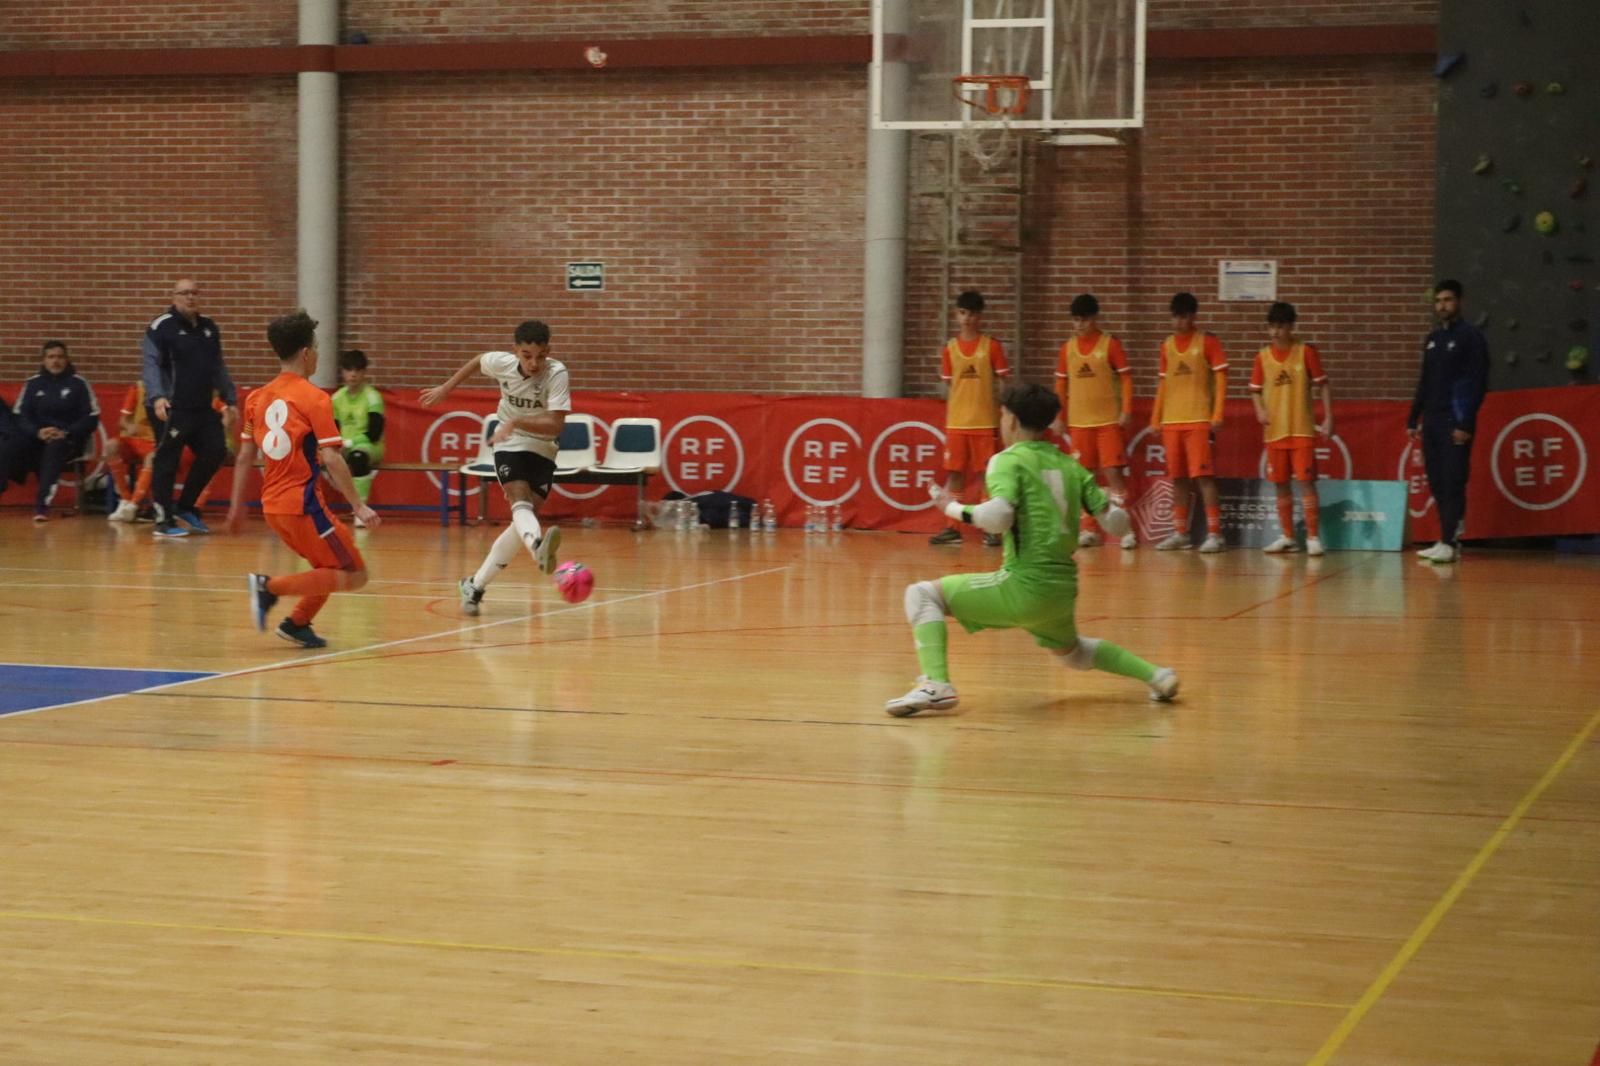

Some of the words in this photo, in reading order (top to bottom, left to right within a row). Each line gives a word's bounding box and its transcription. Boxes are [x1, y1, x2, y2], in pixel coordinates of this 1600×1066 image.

[262, 398, 292, 460] 8
[680, 437, 725, 455] RF
[804, 440, 849, 459] RF
[889, 444, 937, 462] RF
[1146, 444, 1167, 463] R
[1513, 437, 1563, 459] RF
[680, 462, 725, 480] EF
[803, 465, 847, 484] EF
[889, 469, 936, 488] EF
[1515, 465, 1564, 486] EF
